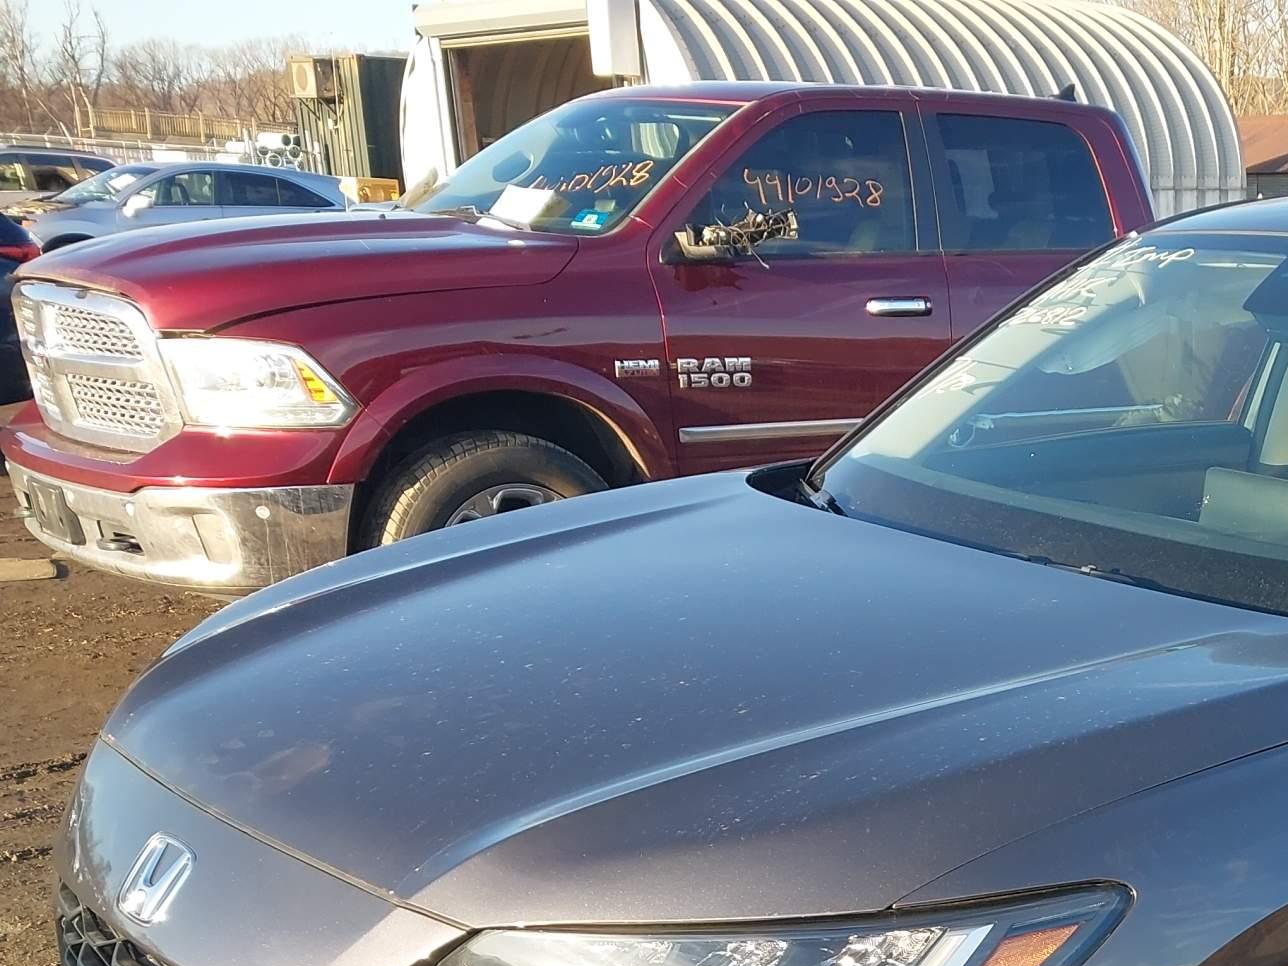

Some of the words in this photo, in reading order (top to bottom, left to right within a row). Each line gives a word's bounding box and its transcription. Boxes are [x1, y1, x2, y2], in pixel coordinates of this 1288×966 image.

[614, 359, 660, 369] HEMI
[677, 357, 752, 372] RAM
[678, 372, 752, 388] 1500
